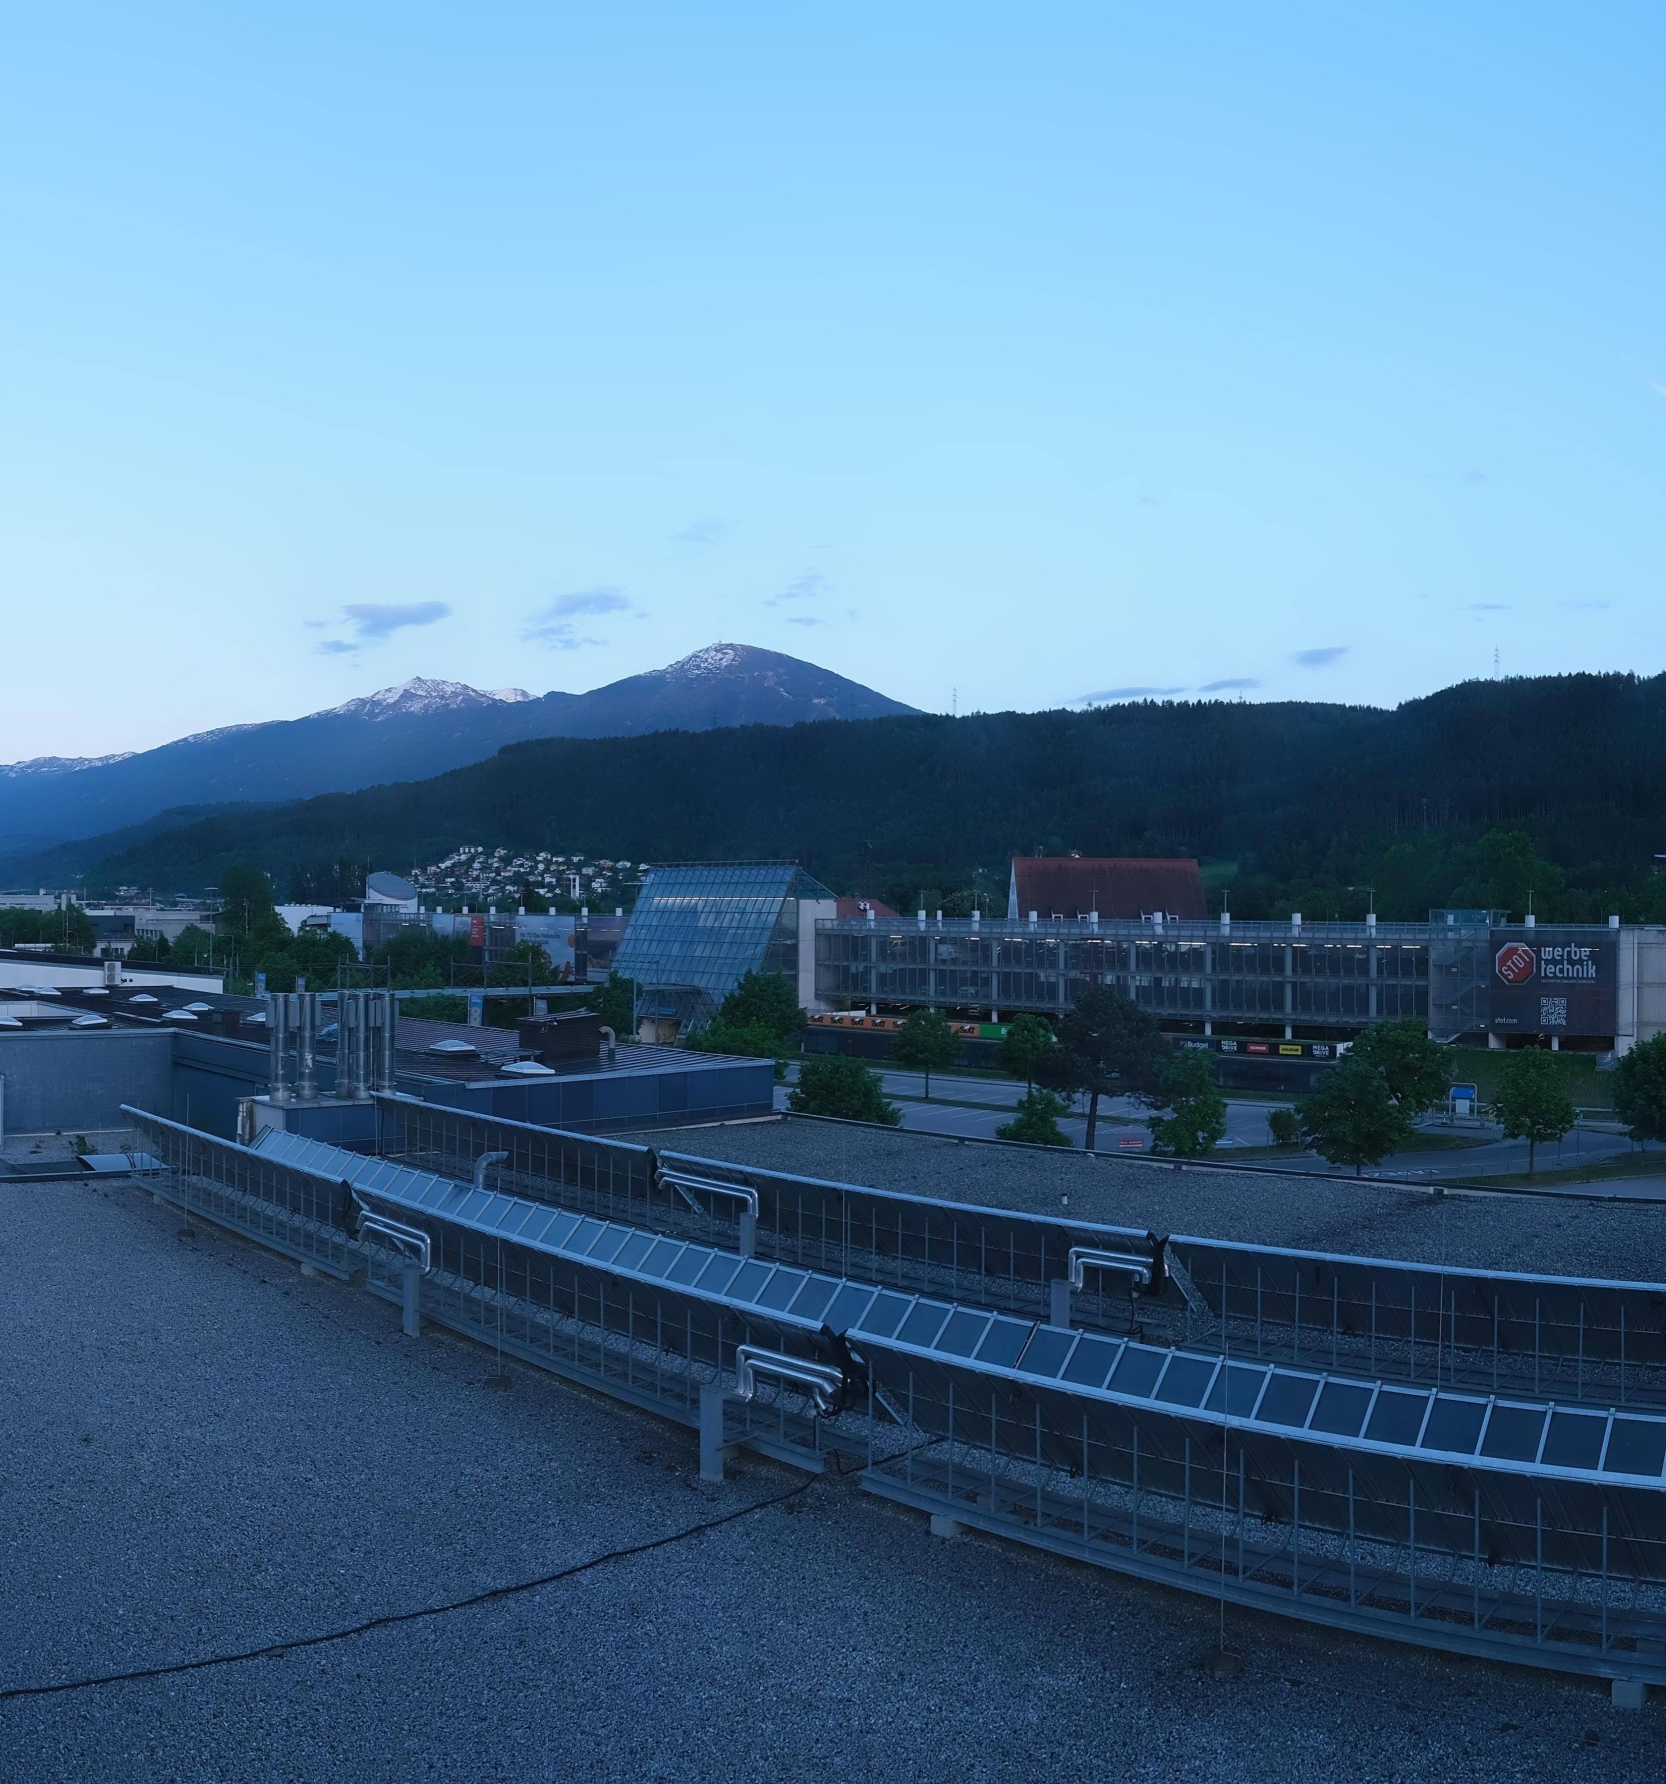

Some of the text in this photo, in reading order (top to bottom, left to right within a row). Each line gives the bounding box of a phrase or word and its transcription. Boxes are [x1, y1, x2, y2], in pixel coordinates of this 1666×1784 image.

[1541, 943, 1590, 960] werbe
[1501, 948, 1530, 980] STOT
[1541, 960, 1596, 978] technik
[1187, 1040, 1209, 1050] Budget
